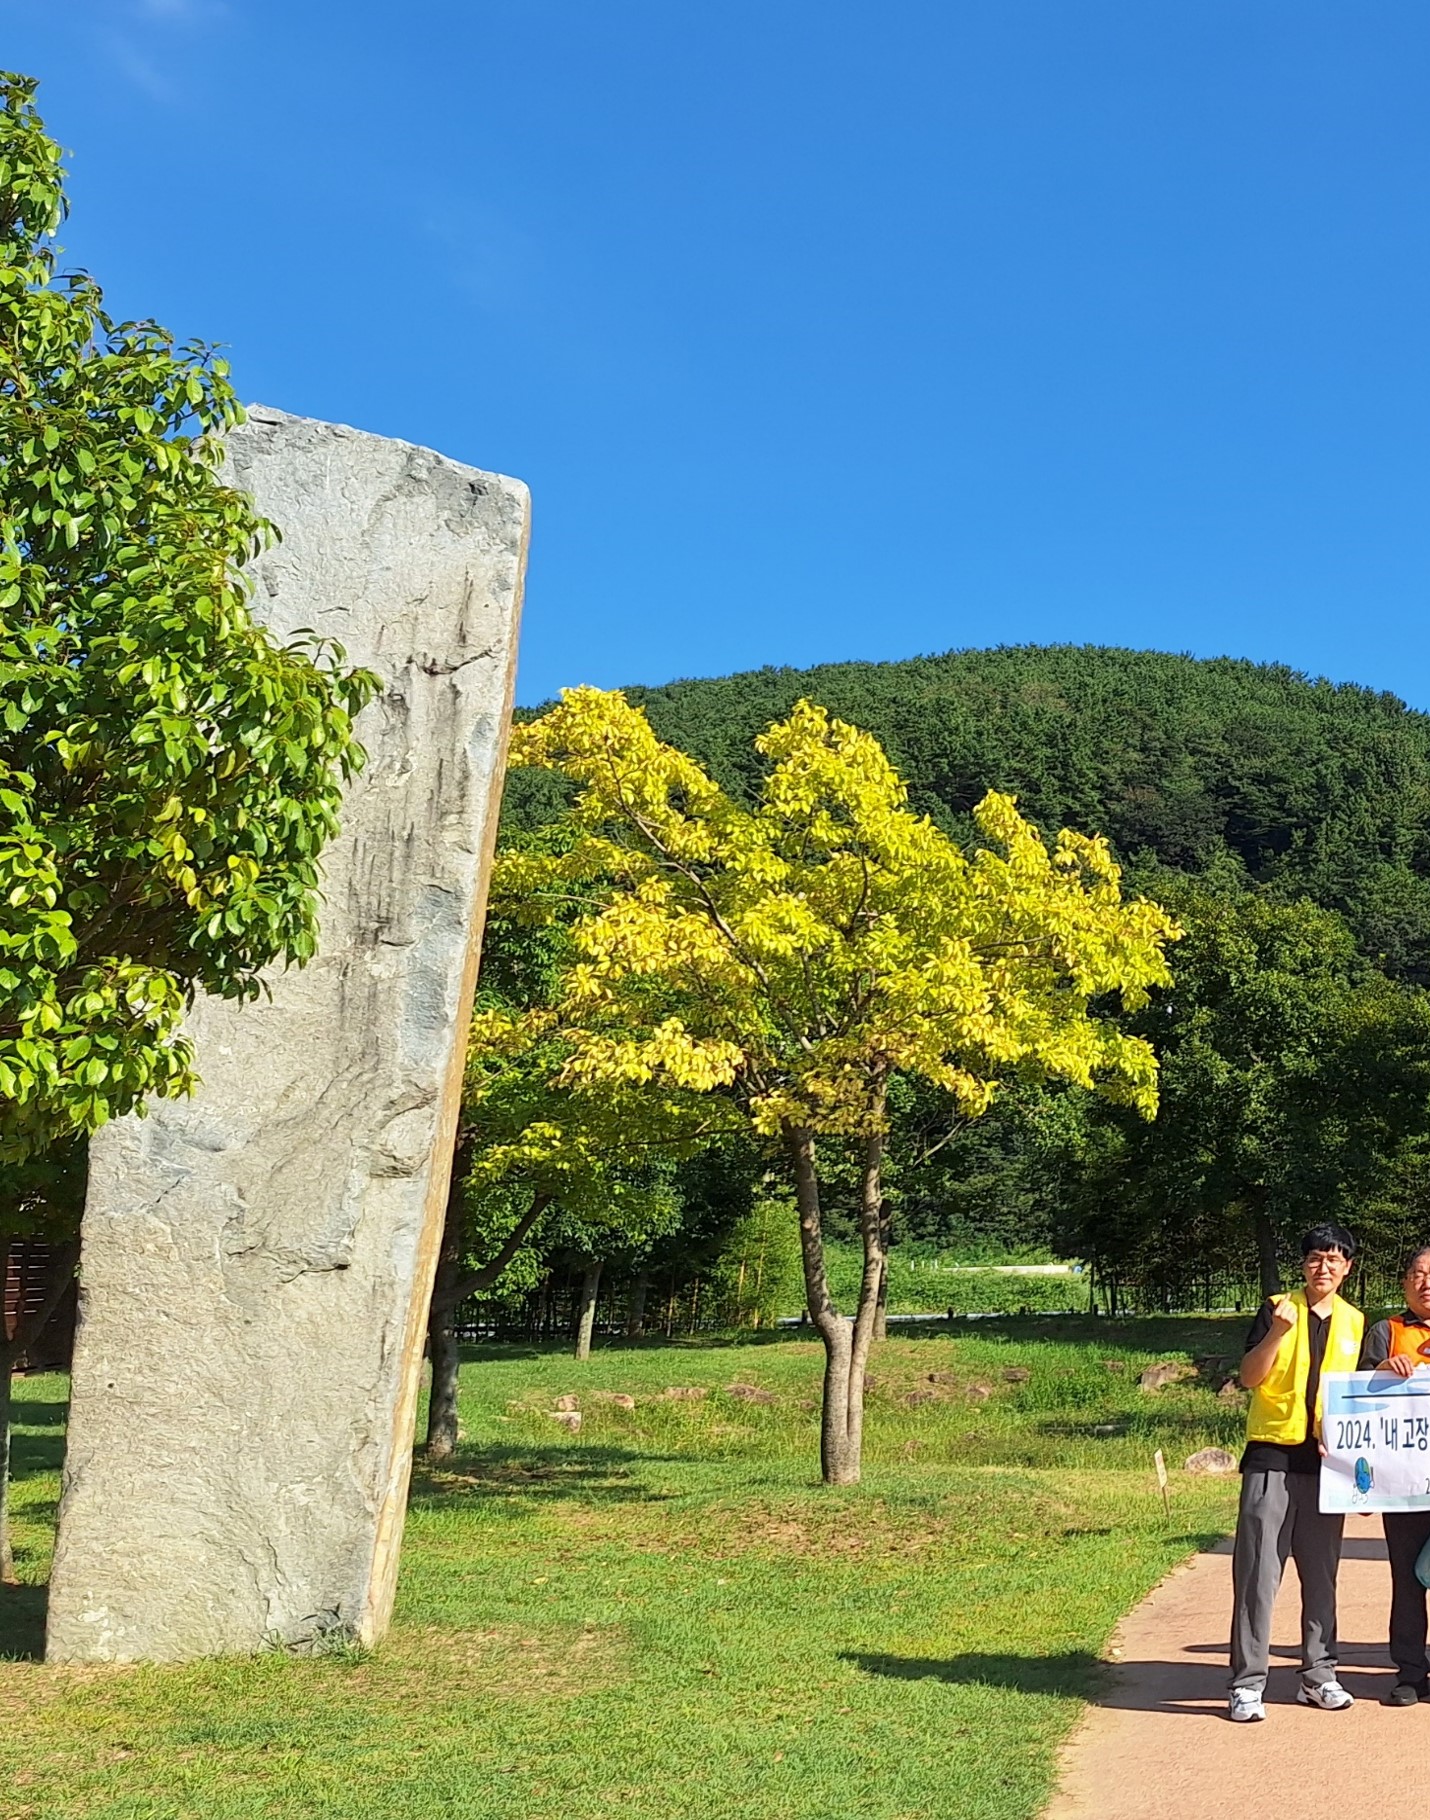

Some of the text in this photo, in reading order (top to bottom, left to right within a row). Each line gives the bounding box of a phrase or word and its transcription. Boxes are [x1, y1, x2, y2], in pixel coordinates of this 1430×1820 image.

[1337, 1419, 1376, 1450] 2024.
[1380, 1416, 1398, 1451] '내
[1402, 1417, 1429, 1451] 고장
